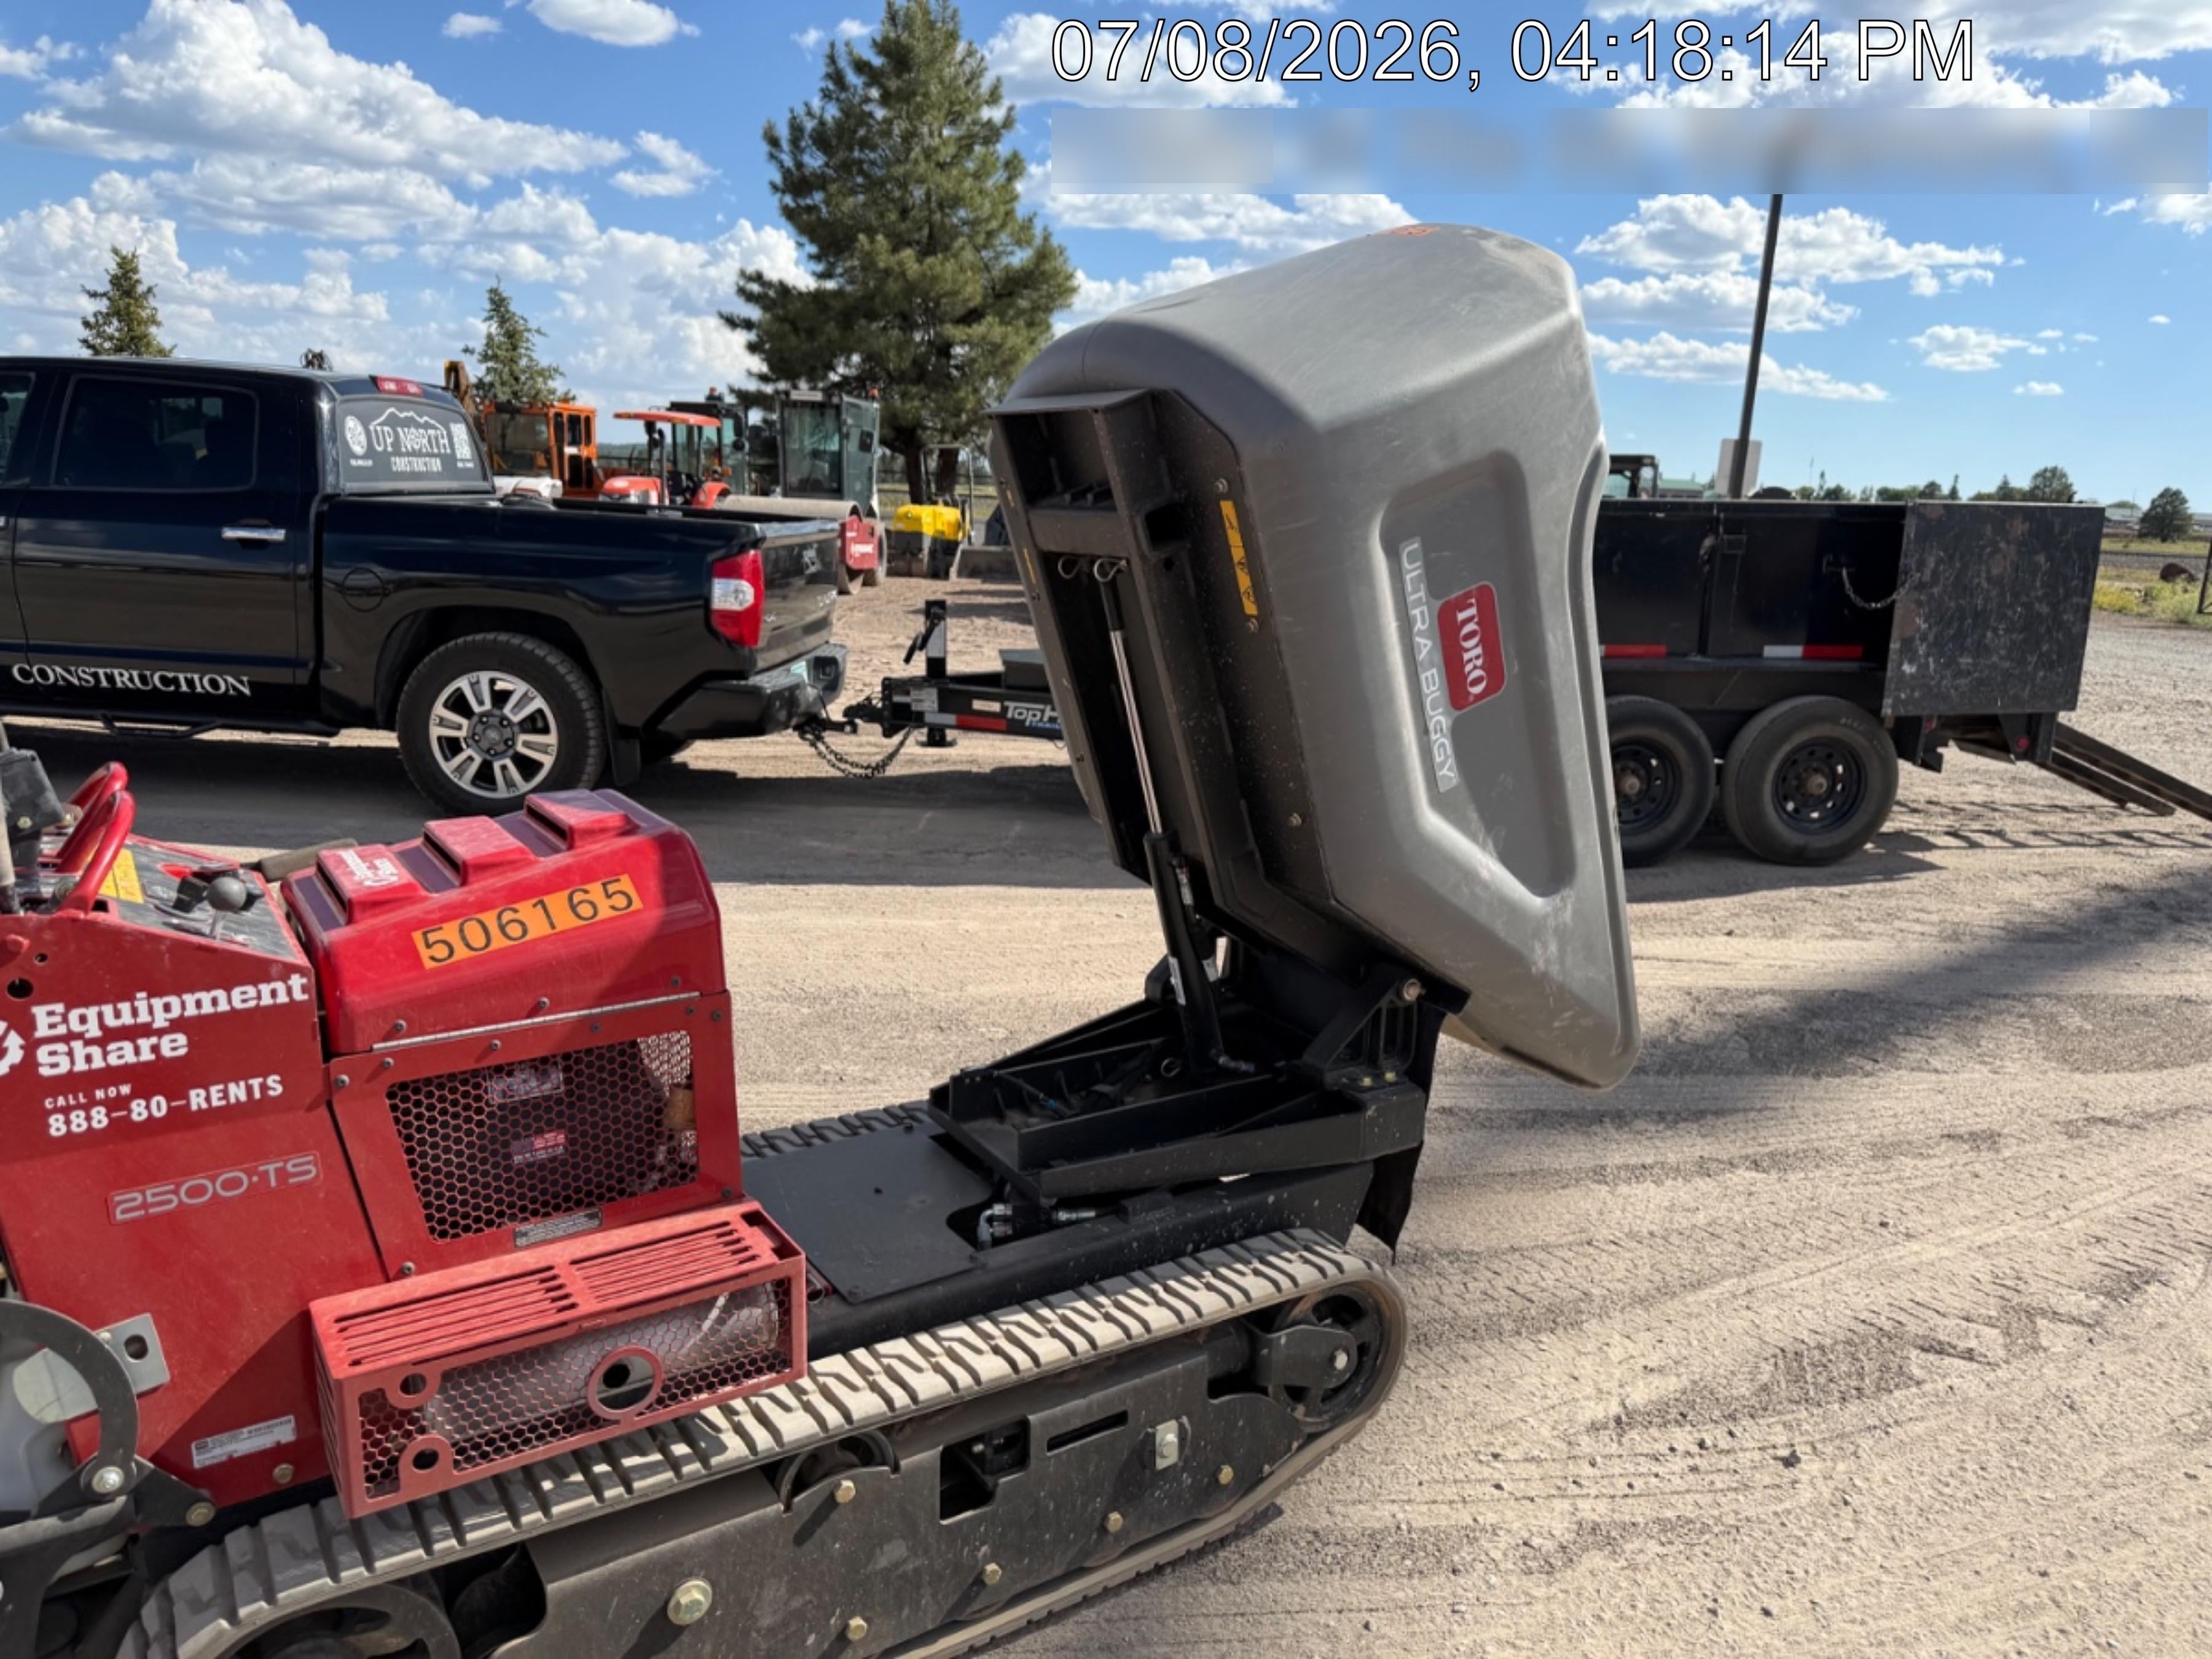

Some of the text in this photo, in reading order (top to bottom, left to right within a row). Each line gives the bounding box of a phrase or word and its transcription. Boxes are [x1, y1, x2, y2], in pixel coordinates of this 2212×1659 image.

[369, 425, 451, 453] UP NORTH
[1403, 543, 1457, 782] ULTRA BUGGY
[1455, 598, 1488, 694] TORO
[12, 662, 251, 696] CONSTRUCTION
[422, 877, 633, 963] 506165
[31, 973, 309, 1039] Equipment
[36, 1032, 189, 1078] Share
[44, 1083, 132, 1110] CALL NOW
[48, 1074, 283, 1137] 888-80-RENTS
